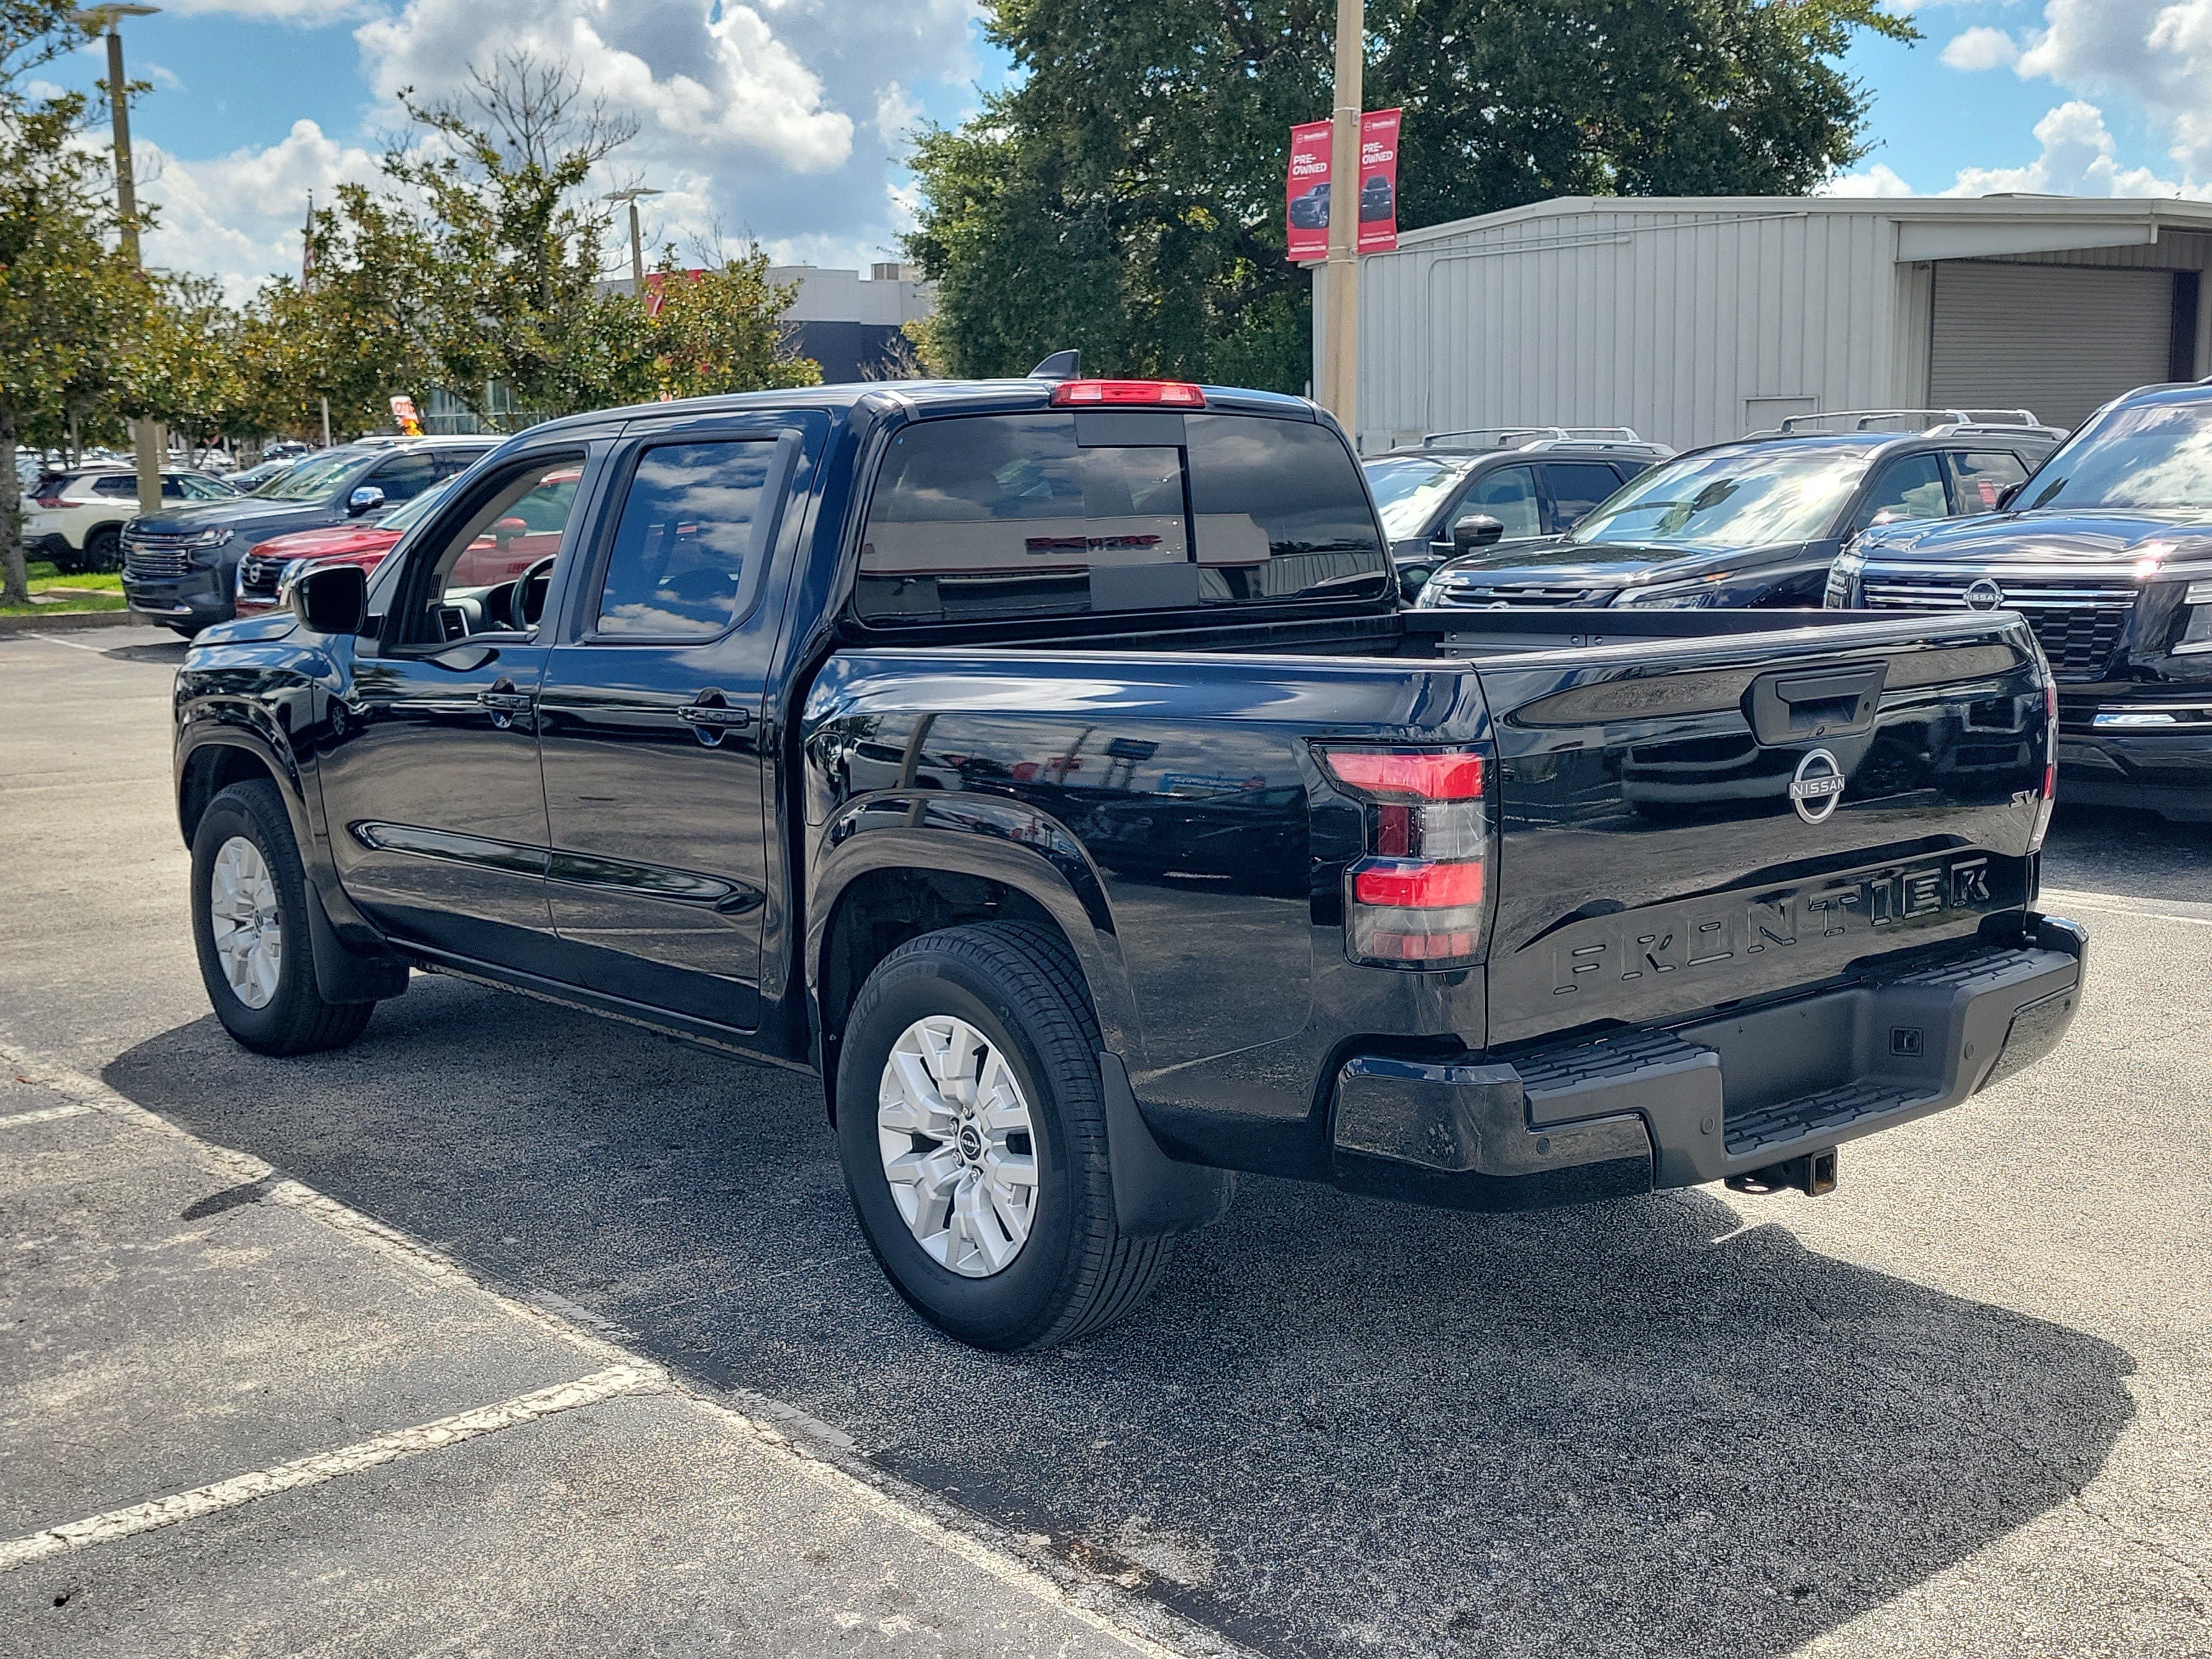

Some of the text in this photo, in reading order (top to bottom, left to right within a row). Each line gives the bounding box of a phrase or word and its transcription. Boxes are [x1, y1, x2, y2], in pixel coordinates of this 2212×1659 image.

[1362, 142, 1384, 154] PRE-
[1293, 154, 1317, 165] PRE-
[1362, 150, 1393, 165] OWNED
[1292, 162, 1327, 175] OWNED
[1792, 777, 1844, 796] NISSAN
[2010, 788, 2038, 808] SV
[1552, 857, 1991, 996] FRONTIER
